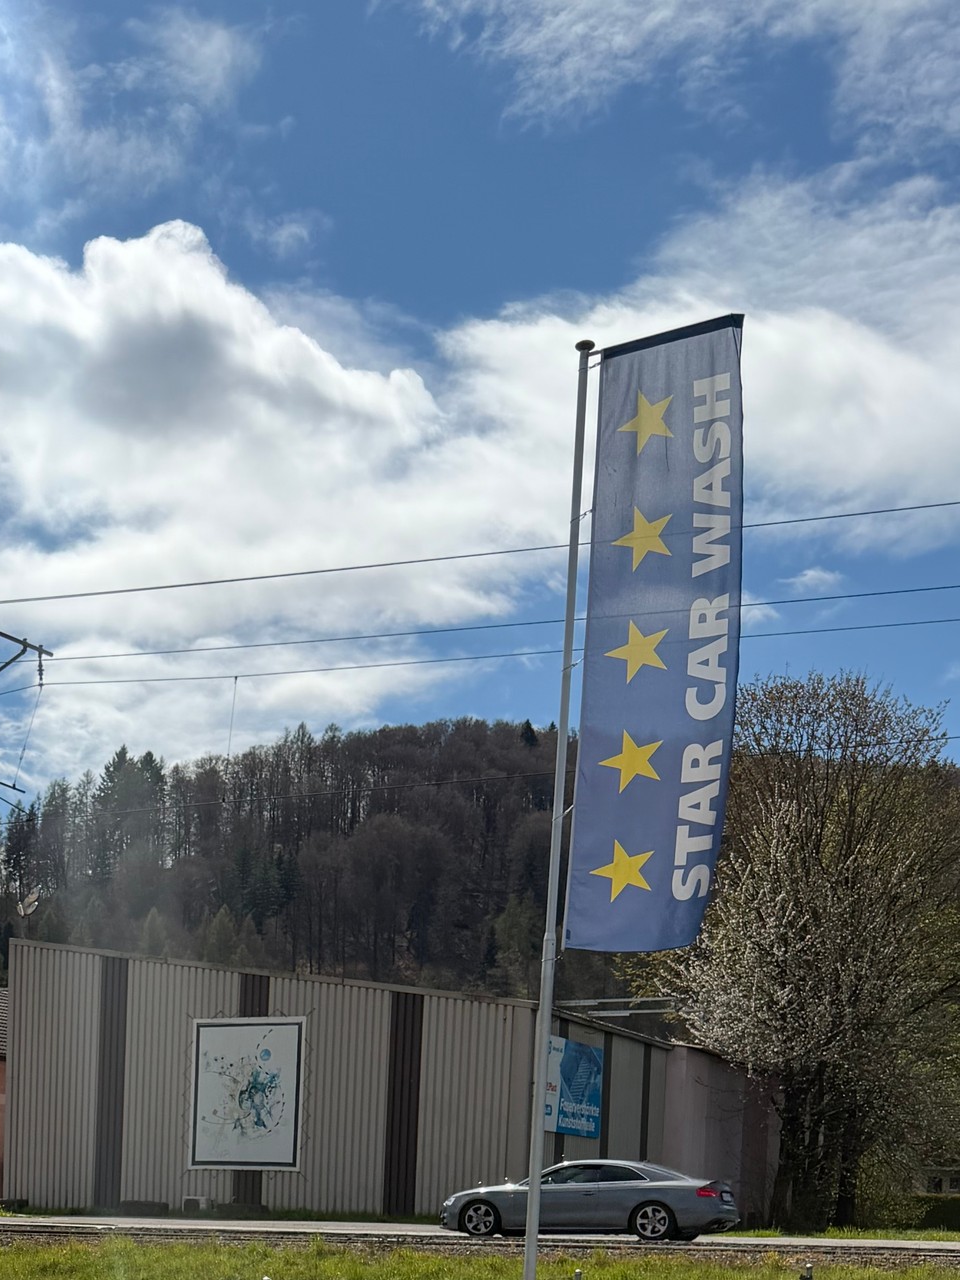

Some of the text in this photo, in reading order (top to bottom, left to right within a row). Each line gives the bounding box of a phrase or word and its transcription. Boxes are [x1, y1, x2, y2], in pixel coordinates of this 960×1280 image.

[671, 372, 732, 901] STAR CAR WASH
